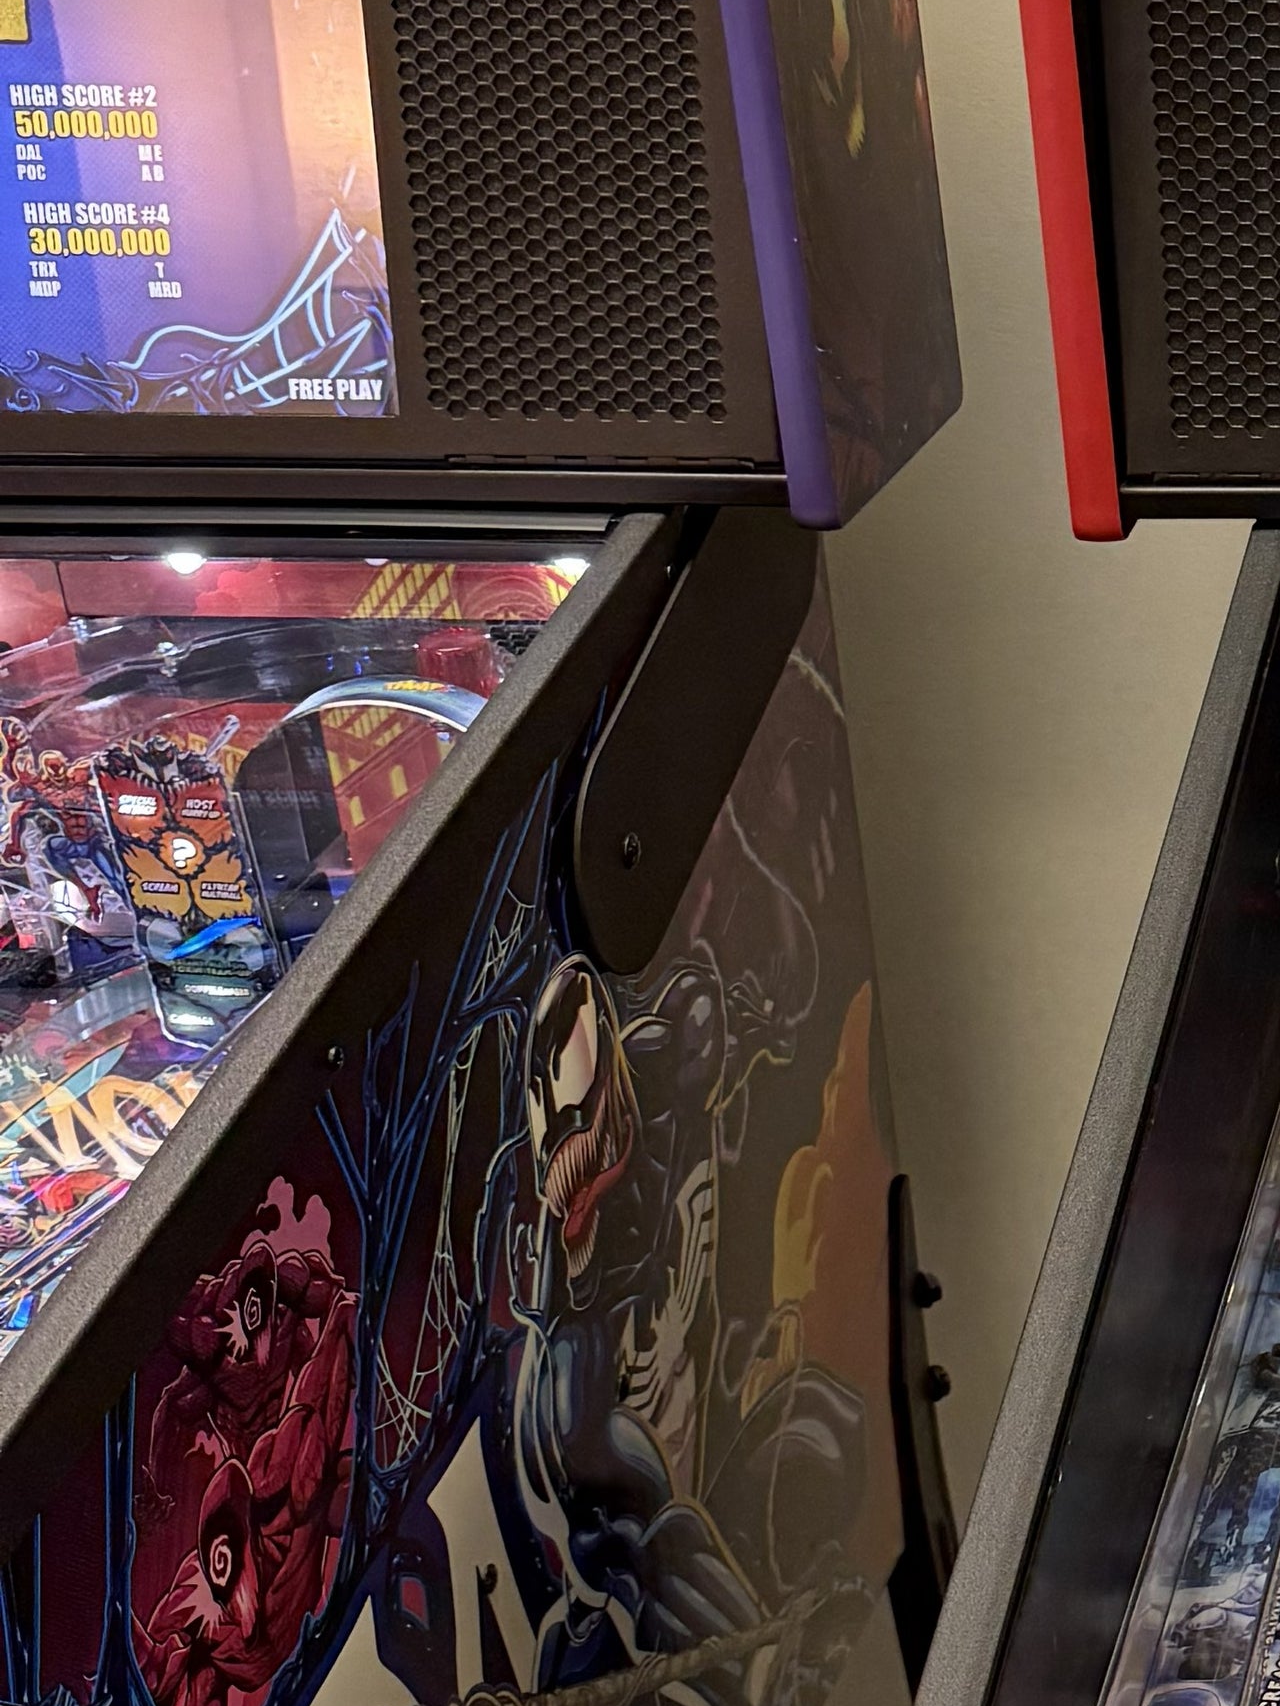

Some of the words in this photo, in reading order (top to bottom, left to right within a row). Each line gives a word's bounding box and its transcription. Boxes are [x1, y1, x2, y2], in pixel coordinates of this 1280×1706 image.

[9, 84, 58, 107] HIGH
[61, 84, 126, 108] SCORE
[128, 85, 158, 107] #2
[15, 110, 158, 141] 50,000,000
[15, 144, 43, 161] DAL
[16, 164, 47, 181] POC
[23, 202, 72, 225] HIGH
[74, 203, 139, 225] SCORE
[140, 203, 171, 225] #4
[28, 227, 171, 258] 30,000,000
[29, 261, 58, 278] TRX
[288, 378, 333, 401] FREE
[336, 378, 382, 401] PLAY
